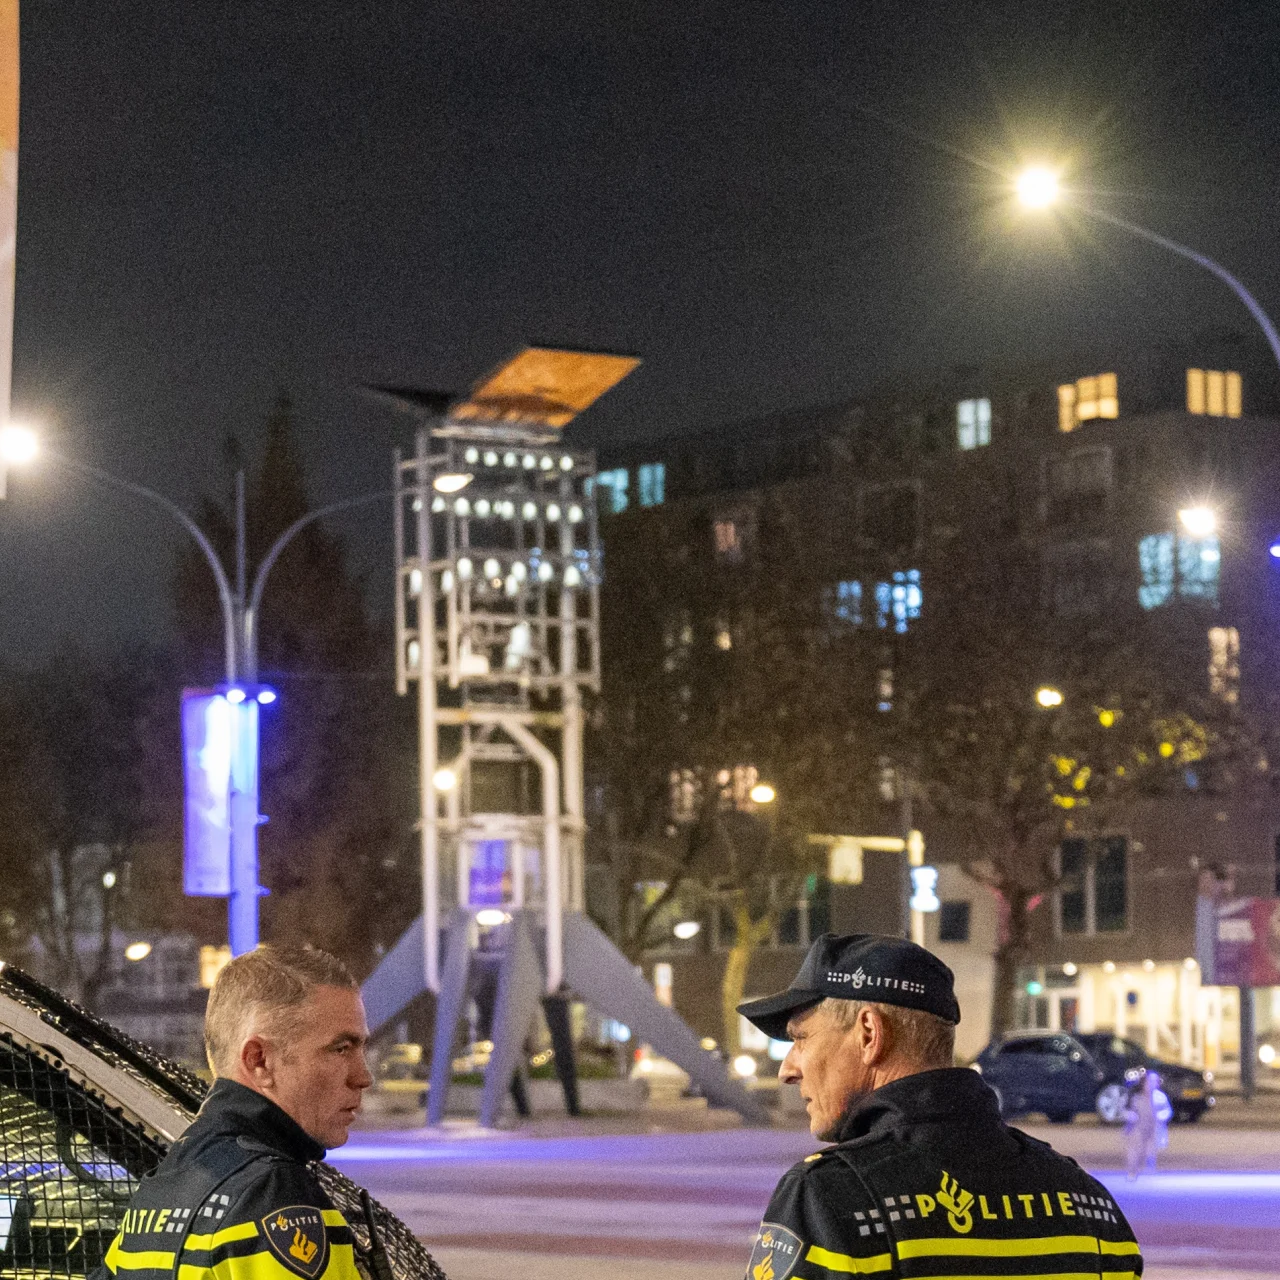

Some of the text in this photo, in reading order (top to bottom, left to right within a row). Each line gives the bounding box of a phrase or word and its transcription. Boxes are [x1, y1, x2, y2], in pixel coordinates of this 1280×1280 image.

[843, 972, 910, 990] POLITIE
[123, 1208, 173, 1234] LITIE
[270, 1215, 319, 1231] POLITIE
[915, 1191, 1077, 1235] POLITIE
